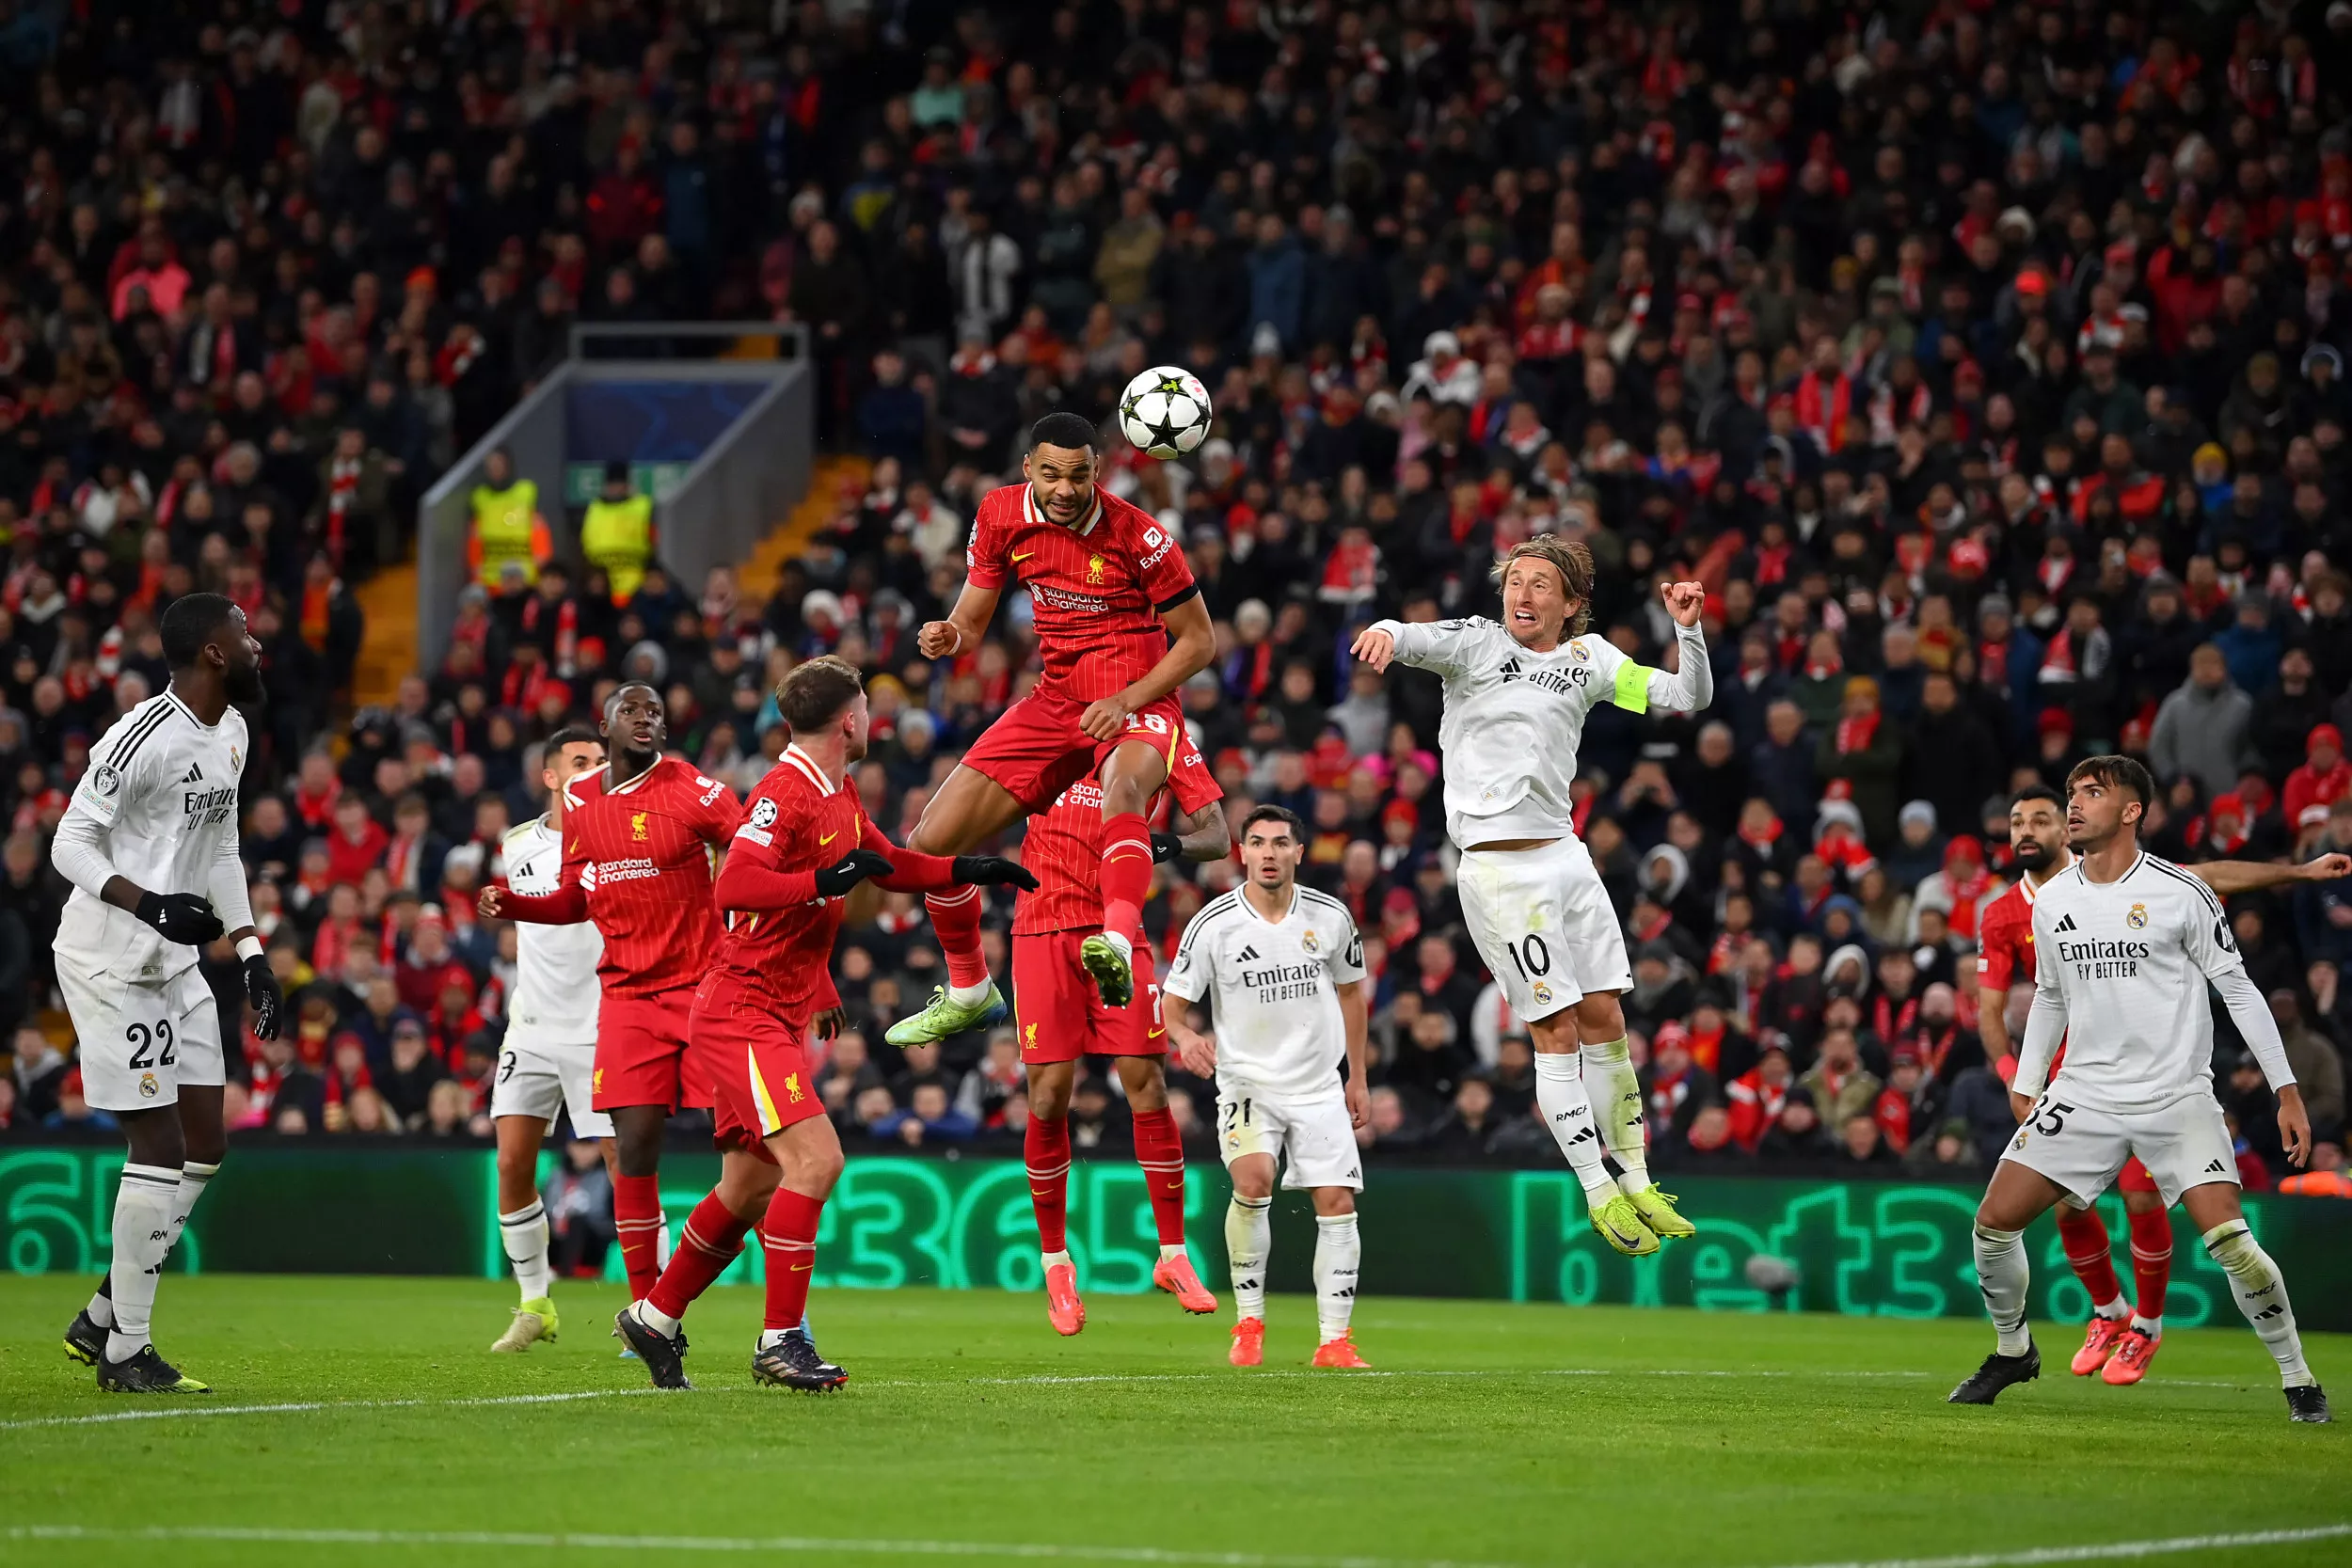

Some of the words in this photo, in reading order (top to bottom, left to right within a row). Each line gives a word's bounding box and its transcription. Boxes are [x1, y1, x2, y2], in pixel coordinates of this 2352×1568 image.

[1087, 576, 1104, 584] LFC
[1047, 596, 1108, 612] chartered
[101, 779, 109, 787] 15
[1072, 783, 1104, 798] stan
[184, 786, 236, 815] Emirate
[597, 858, 652, 875] standard
[598, 866, 660, 884] chartered
[1507, 933, 1550, 983] 10
[2058, 937, 2149, 962] Emirates
[1243, 961, 1321, 988] Emirates
[2096, 961, 2137, 979] BETTER
[1260, 990, 1277, 1004] FLY
[1280, 982, 1319, 1001] BETTER
[1147, 984, 1161, 1025] 7
[126, 1019, 175, 1069] 22
[1224, 1098, 1252, 1134] 21
[1556, 1103, 1588, 1122] RMCF
[2024, 1094, 2075, 1137] 35
[150, 1229, 168, 1241] RM
[2245, 1280, 2277, 1300] RMCF
